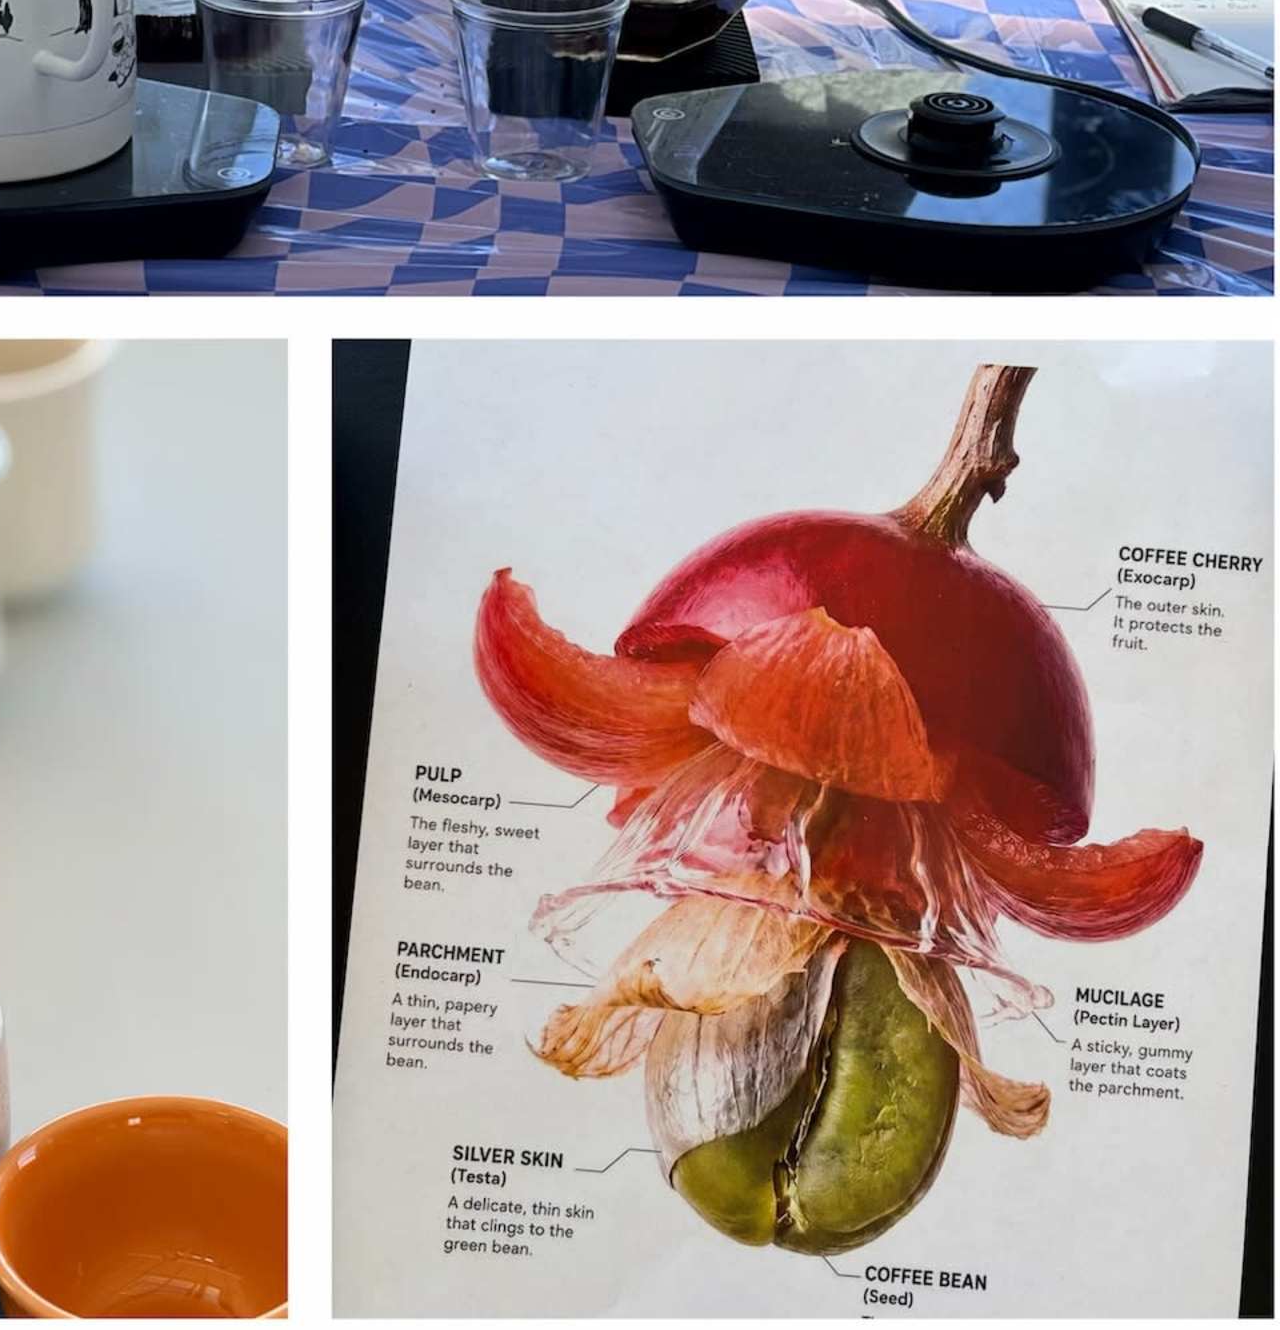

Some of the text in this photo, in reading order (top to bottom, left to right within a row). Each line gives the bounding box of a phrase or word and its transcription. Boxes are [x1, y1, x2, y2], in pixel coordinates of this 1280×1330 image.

[1119, 546, 1263, 573] COFFEE CHERRY
[1117, 568, 1196, 590] (Exocarp)
[1116, 595, 1225, 618] The outer skin.
[1113, 615, 1223, 637] It protects the
[1112, 635, 1148, 651] fruit.
[415, 765, 463, 783] PULP
[412, 786, 501, 810] (Mesocarp)
[410, 815, 540, 840] The fleshy, sweet
[407, 836, 480, 855] layer that
[405, 859, 513, 877] surrounds the
[397, 941, 505, 964] PARCHMENT
[395, 963, 481, 987] (Endocarp)
[391, 992, 498, 1018] A thin, papery
[1075, 987, 1165, 1009] MUCILAGE
[390, 1012, 462, 1031] layer that
[1073, 1009, 1180, 1034] (Pectin Layer)
[388, 1035, 494, 1055] surrounds the
[1071, 1038, 1193, 1064] A sticky, gummy
[385, 1051, 428, 1070] bean.
[1070, 1057, 1188, 1080] layer that coats
[1069, 1078, 1184, 1100] the parchment.
[452, 1145, 564, 1168] SILVER SKIN
[451, 1167, 507, 1188] (Testa)
[448, 1195, 595, 1219] A delicate, thin skin
[446, 1216, 574, 1238] that clings to the
[443, 1239, 534, 1257] green bean.
[865, 1265, 987, 1291] COFFEE BEAN
[863, 1287, 913, 1309] (Seed)
